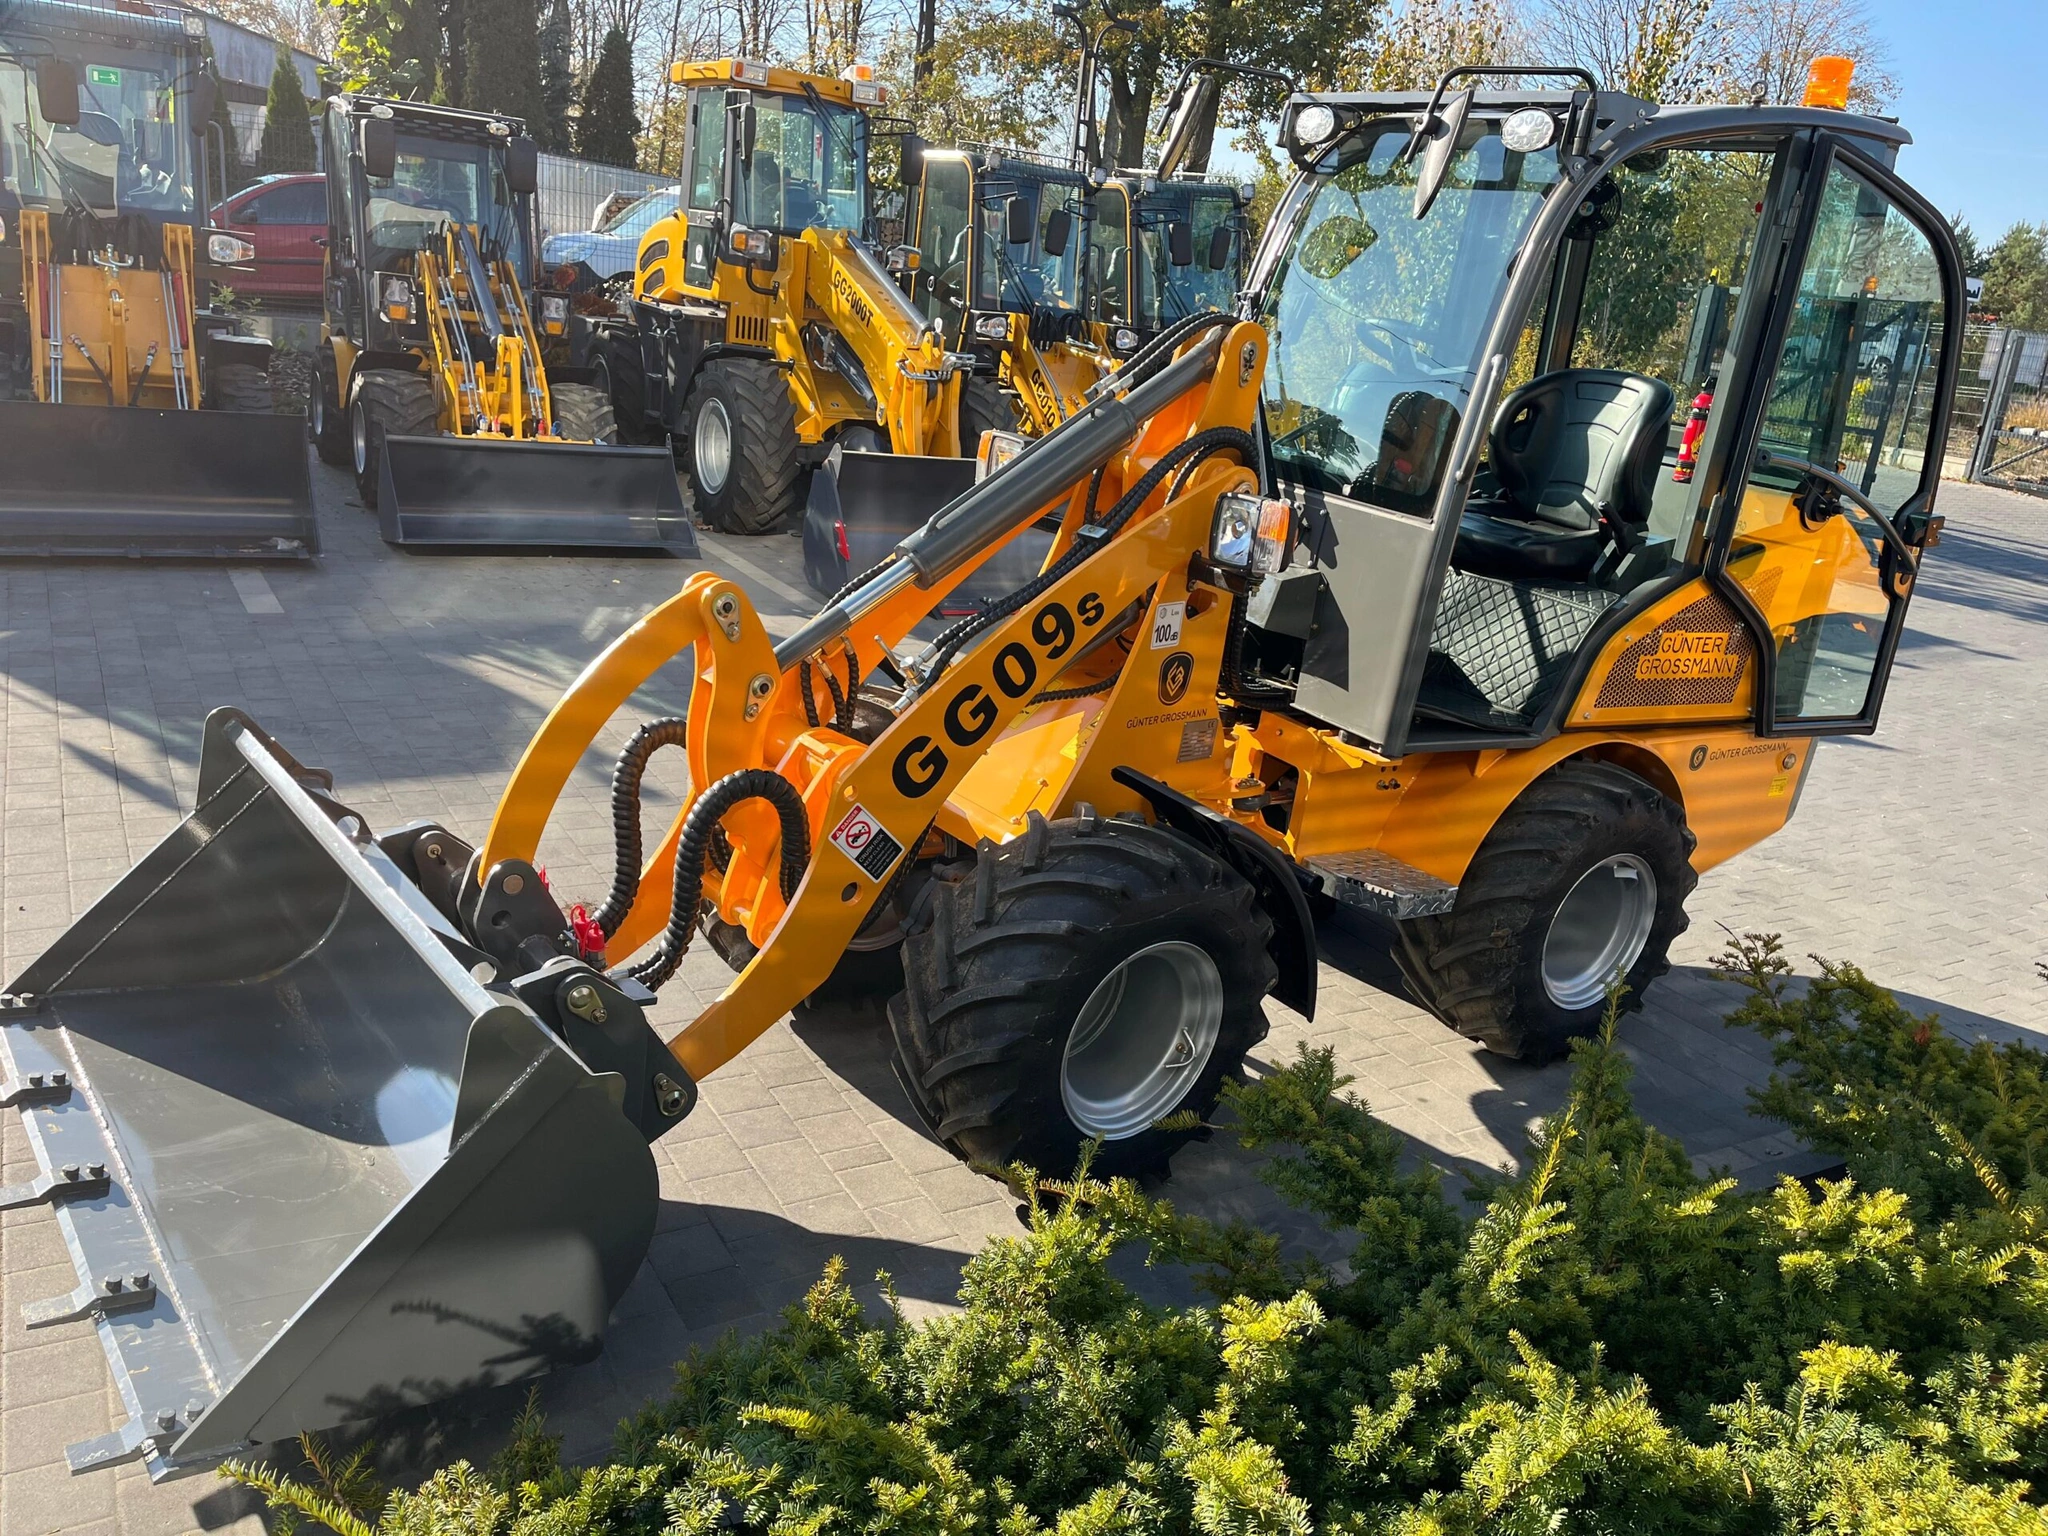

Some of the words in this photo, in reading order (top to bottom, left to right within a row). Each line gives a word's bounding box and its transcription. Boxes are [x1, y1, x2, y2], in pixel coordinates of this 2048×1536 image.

[834, 270, 873, 328] GG2000T
[1661, 633, 1724, 654] GÜNTER
[1640, 657, 1734, 675] GROSSMANN
[1126, 716, 1159, 729] GÜNTER
[1160, 708, 1208, 724] GROSSMANN
[1710, 748, 1744, 760] GÜNTER
[1742, 742, 1788, 756] GROSSMANN
[840, 809, 858, 830] DANGER
[858, 844, 874, 862] CRUSH
[872, 832, 884, 845] RISK
